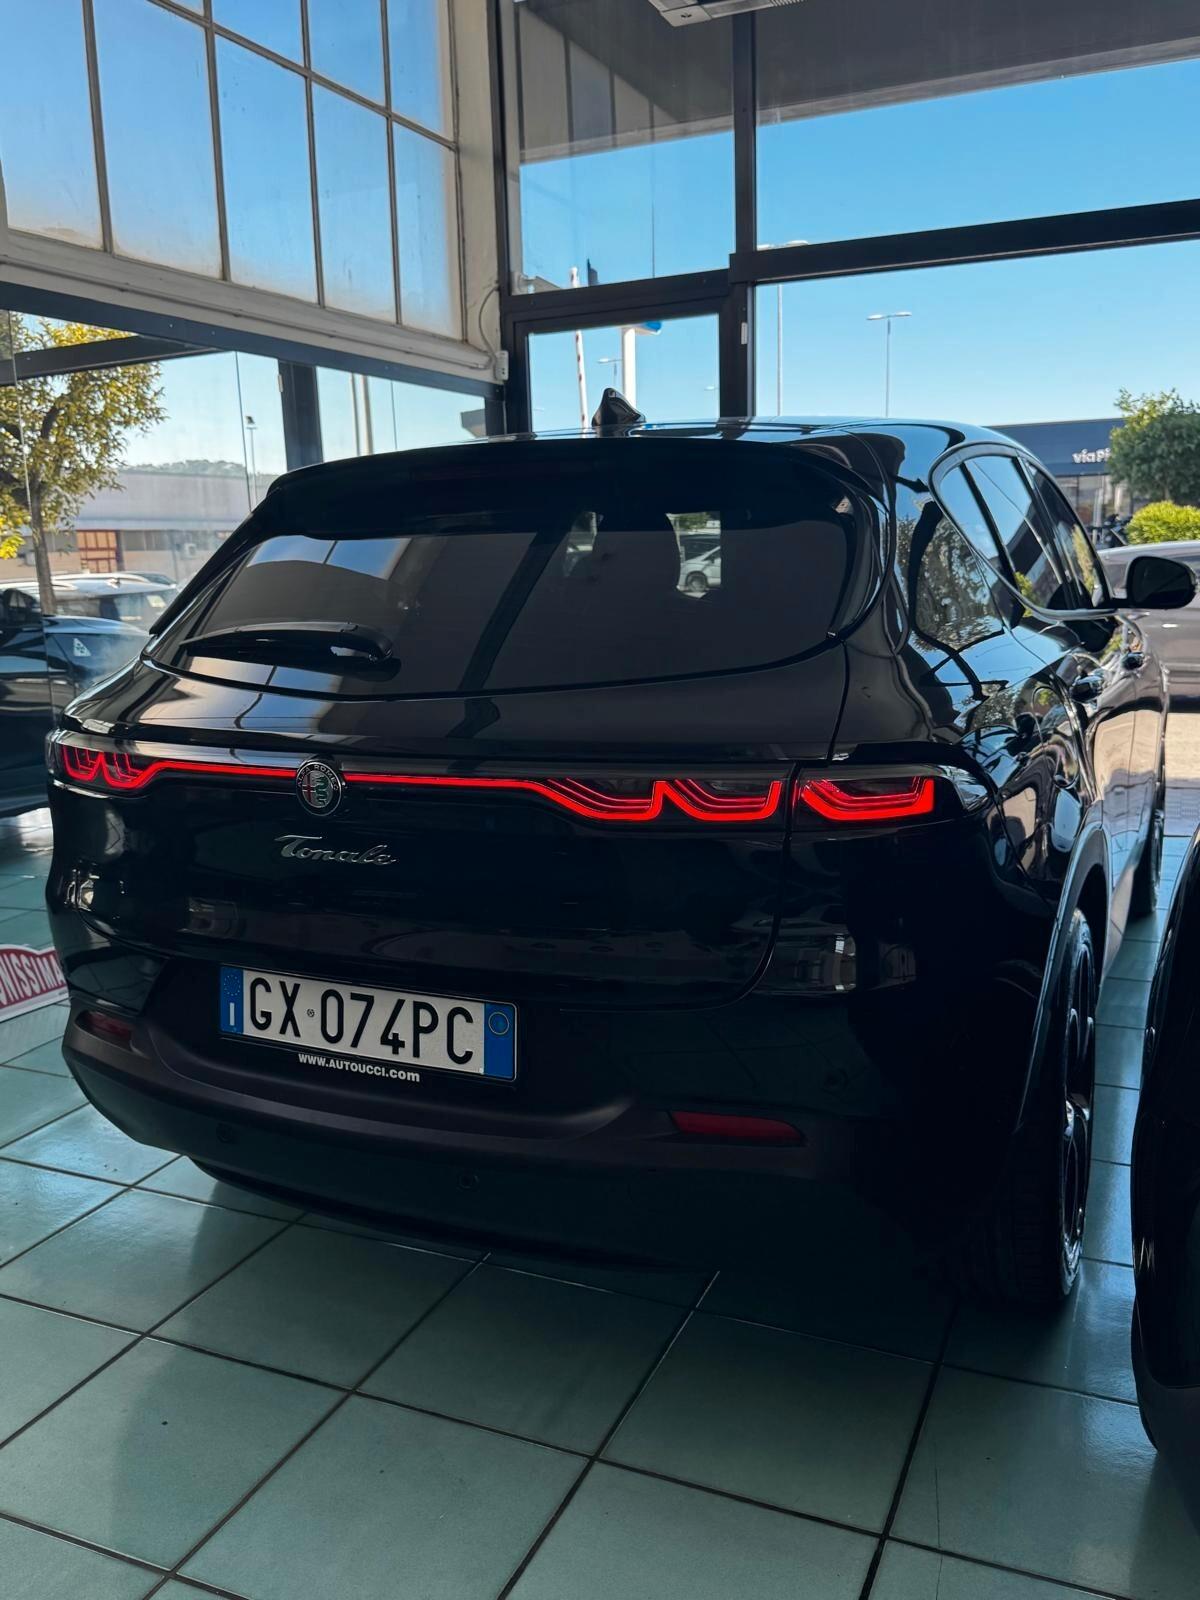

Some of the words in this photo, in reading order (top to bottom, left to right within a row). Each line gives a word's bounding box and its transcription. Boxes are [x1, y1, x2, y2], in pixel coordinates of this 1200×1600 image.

[314, 764, 339, 790] ROMEO
[274, 834, 397, 866] Tonale
[249, 976, 301, 1038] GX
[320, 988, 474, 1065] 074PC
